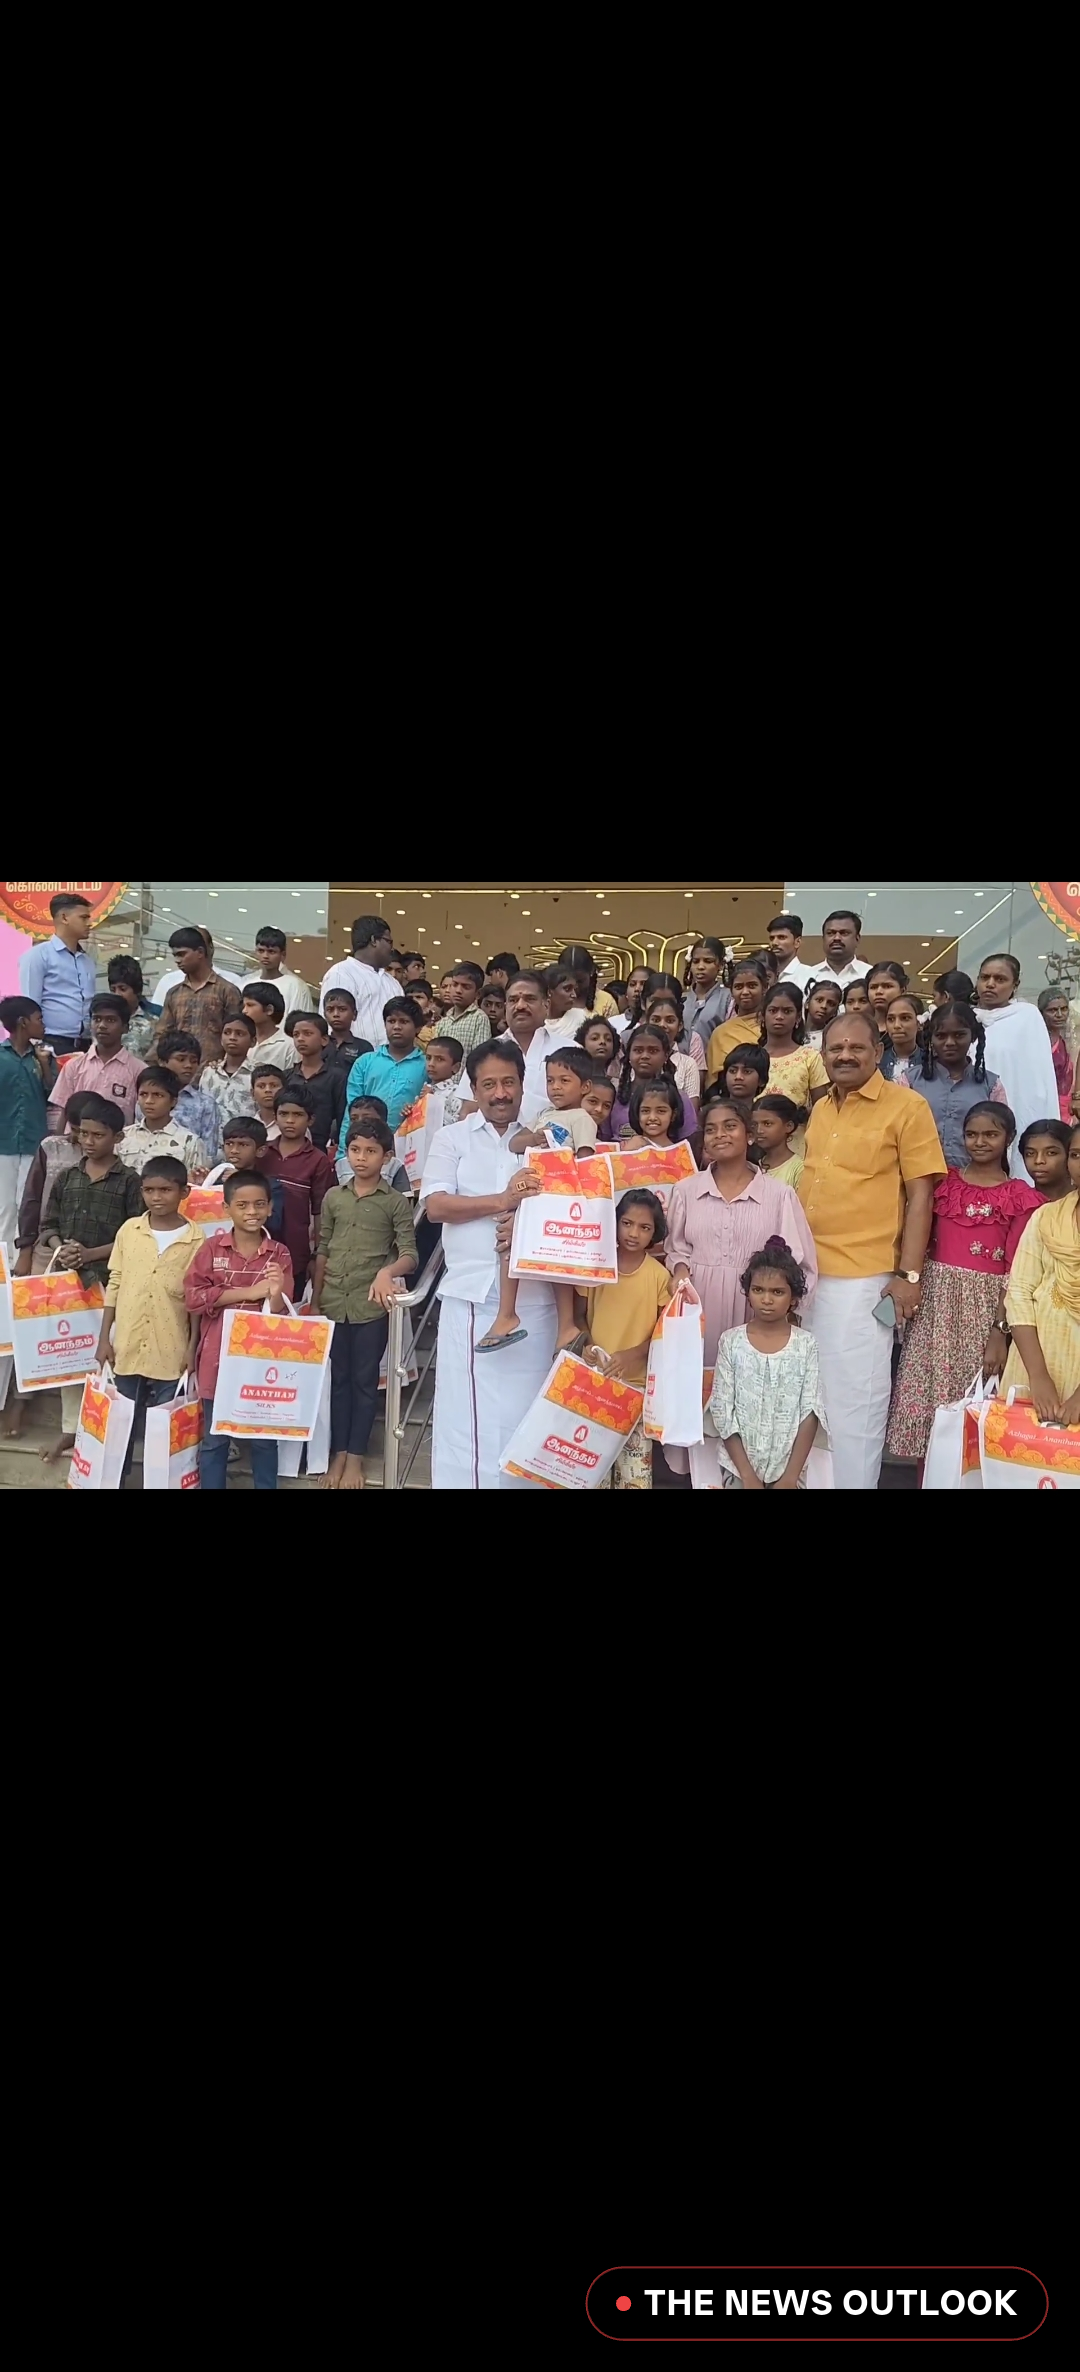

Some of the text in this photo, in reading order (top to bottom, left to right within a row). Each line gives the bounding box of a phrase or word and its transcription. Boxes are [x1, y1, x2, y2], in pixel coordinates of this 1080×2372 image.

[546, 1223, 600, 1239] ஆனந்தம்
[39, 1336, 93, 1354] ஆனந்தம்
[241, 1388, 295, 1399] ANANTHAM
[546, 1438, 597, 1466] ஆனந்தம்
